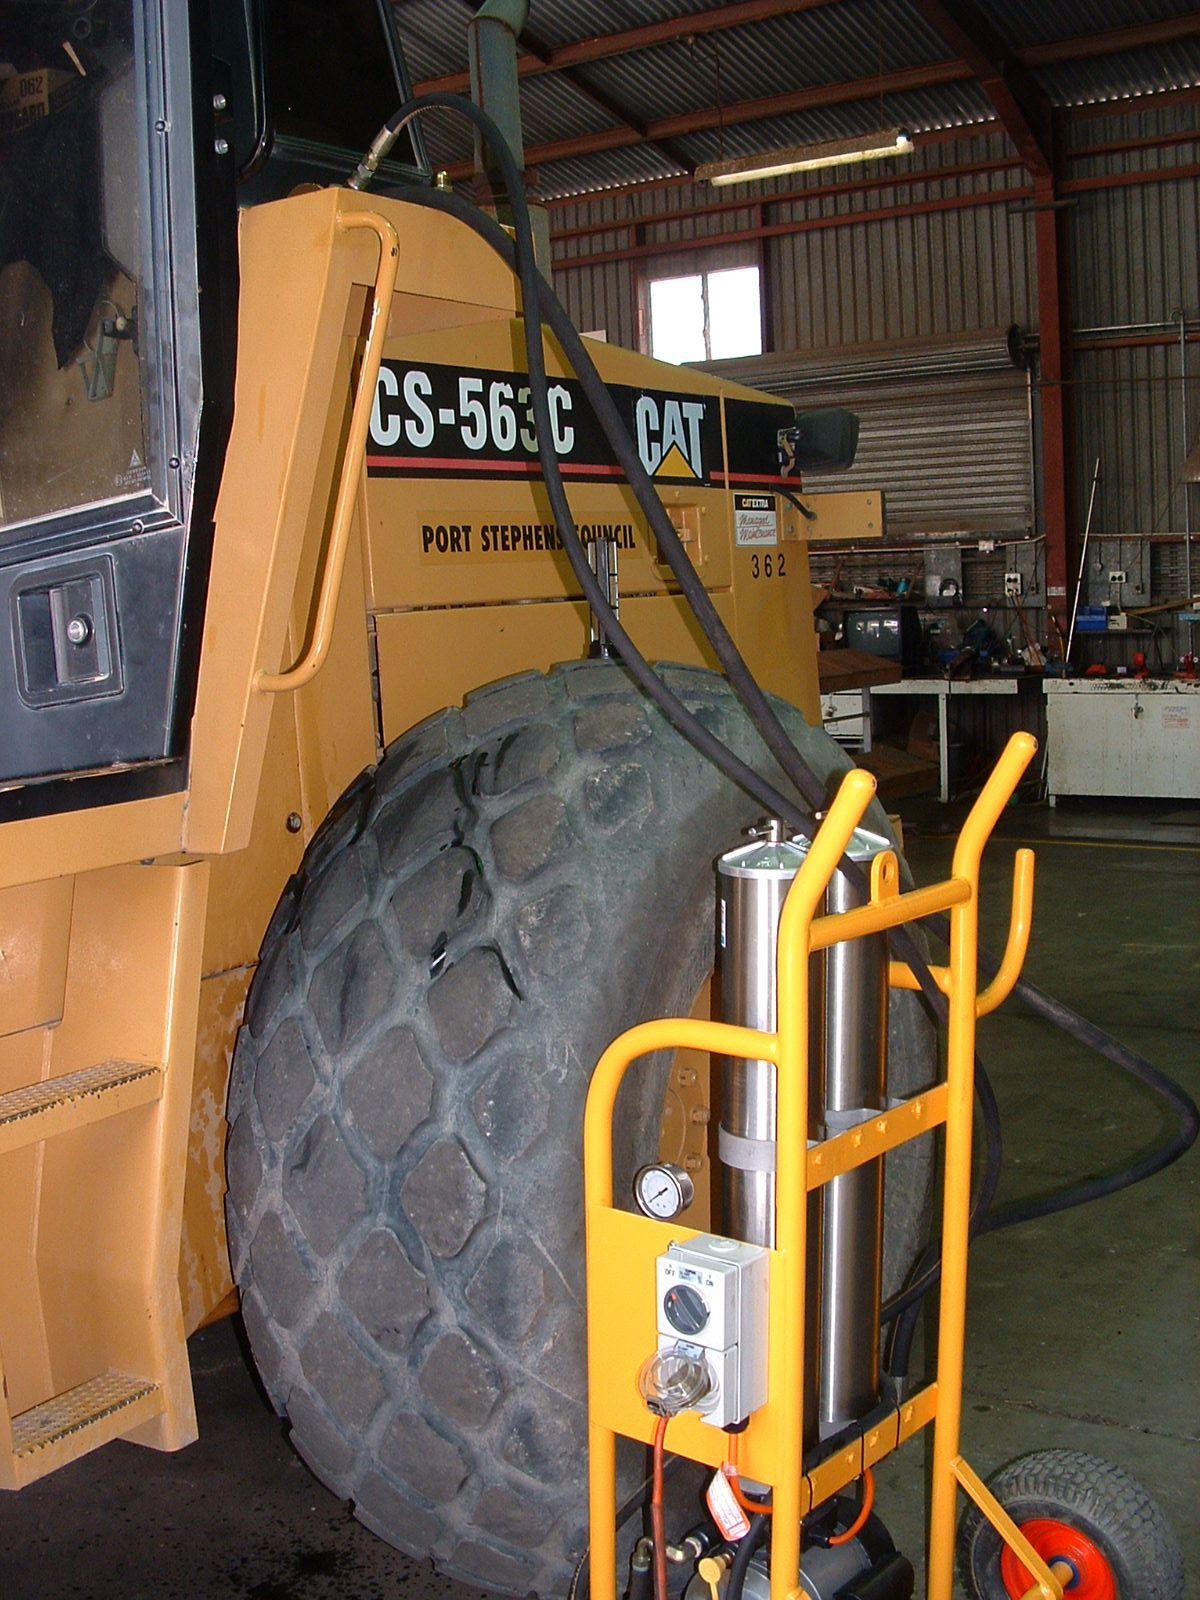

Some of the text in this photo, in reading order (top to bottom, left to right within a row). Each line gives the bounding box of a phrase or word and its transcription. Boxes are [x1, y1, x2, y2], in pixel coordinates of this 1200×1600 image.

[369, 366, 575, 455] CS-563C
[636, 396, 704, 479] CAT
[422, 525, 471, 553] PORT
[574, 524, 636, 549] OUNCIL
[751, 553, 786, 579] 362
